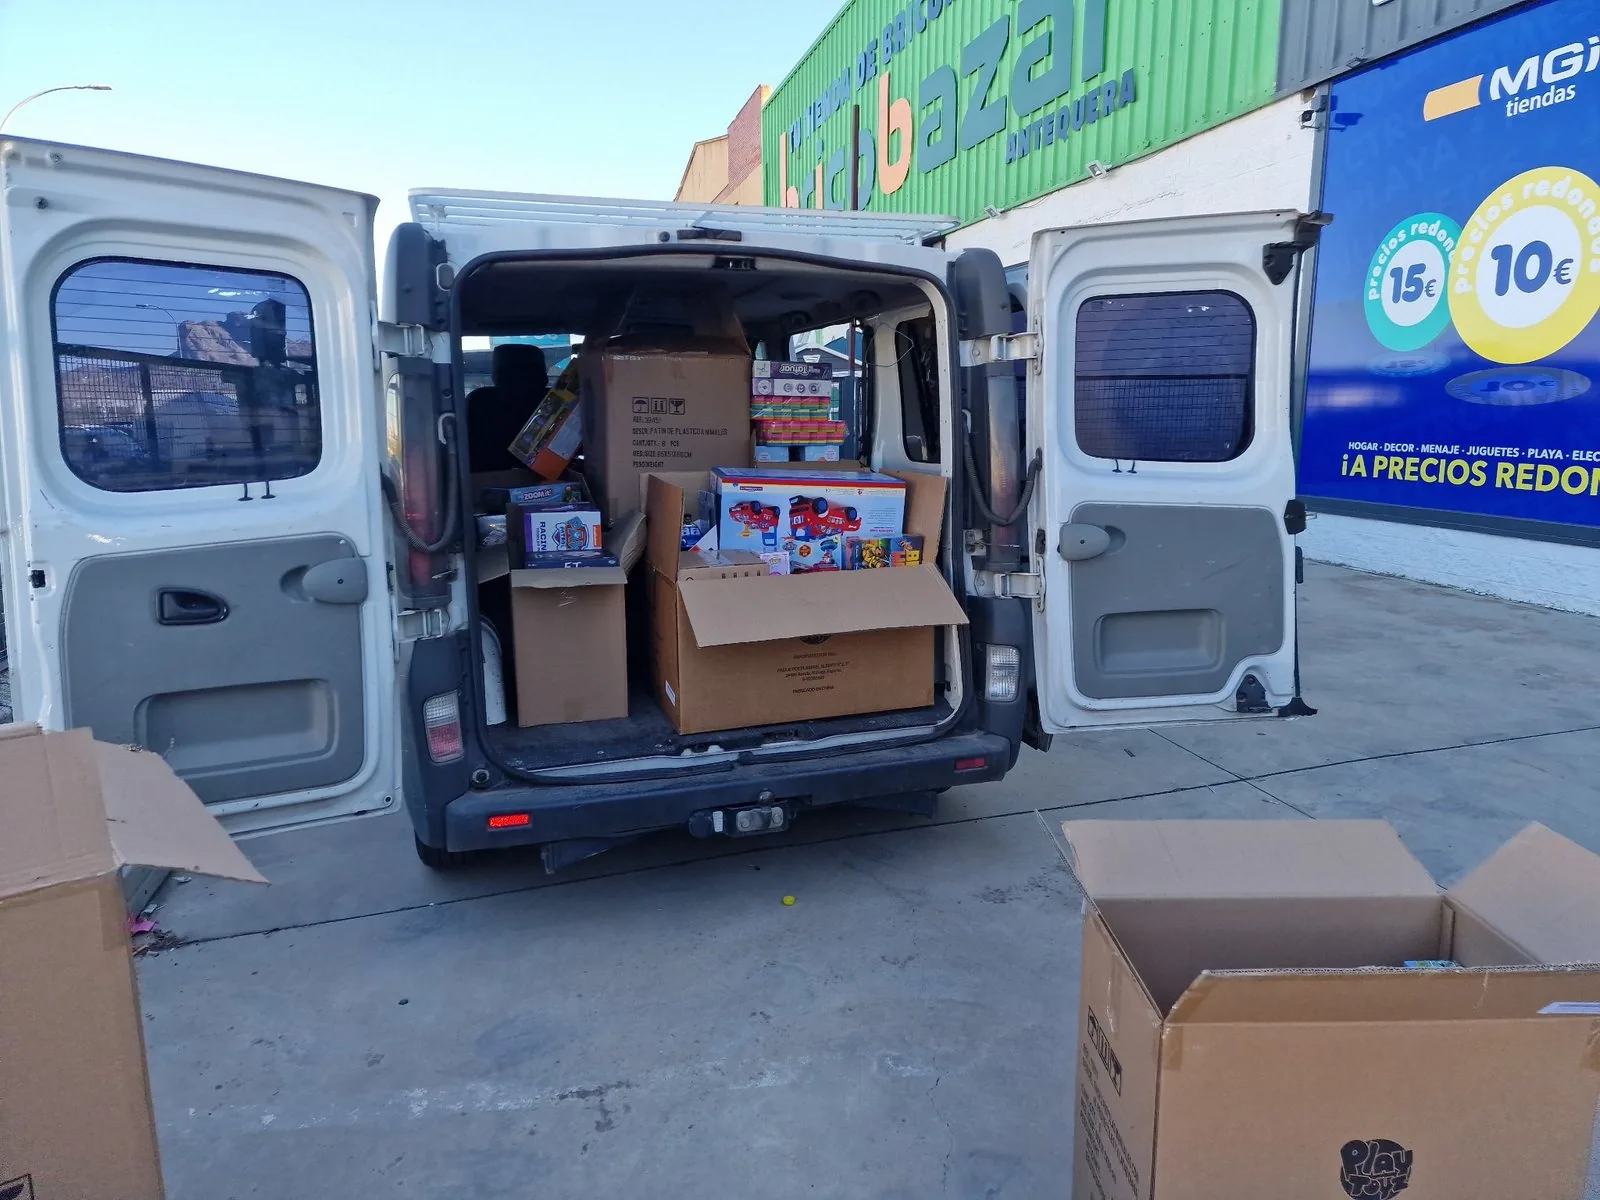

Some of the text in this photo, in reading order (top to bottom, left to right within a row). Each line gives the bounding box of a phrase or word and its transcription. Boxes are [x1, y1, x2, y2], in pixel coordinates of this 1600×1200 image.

[805, 67, 850, 140] TIENDA
[856, 38, 878, 91] DE
[1506, 84, 1576, 117] tiendas
[1005, 67, 1136, 164] ANTEQUERA
[1389, 262, 1437, 304] 15€
[1491, 240, 1574, 296] 10€
[1348, 441, 1378, 451] HOGAR
[1383, 442, 1415, 453] DECOR
[1420, 443, 1460, 455] MENAJE
[1466, 445, 1520, 458] JUGUETES
[1527, 447, 1564, 460] PLAYA
[1372, 455, 1488, 487] PRECIOS
